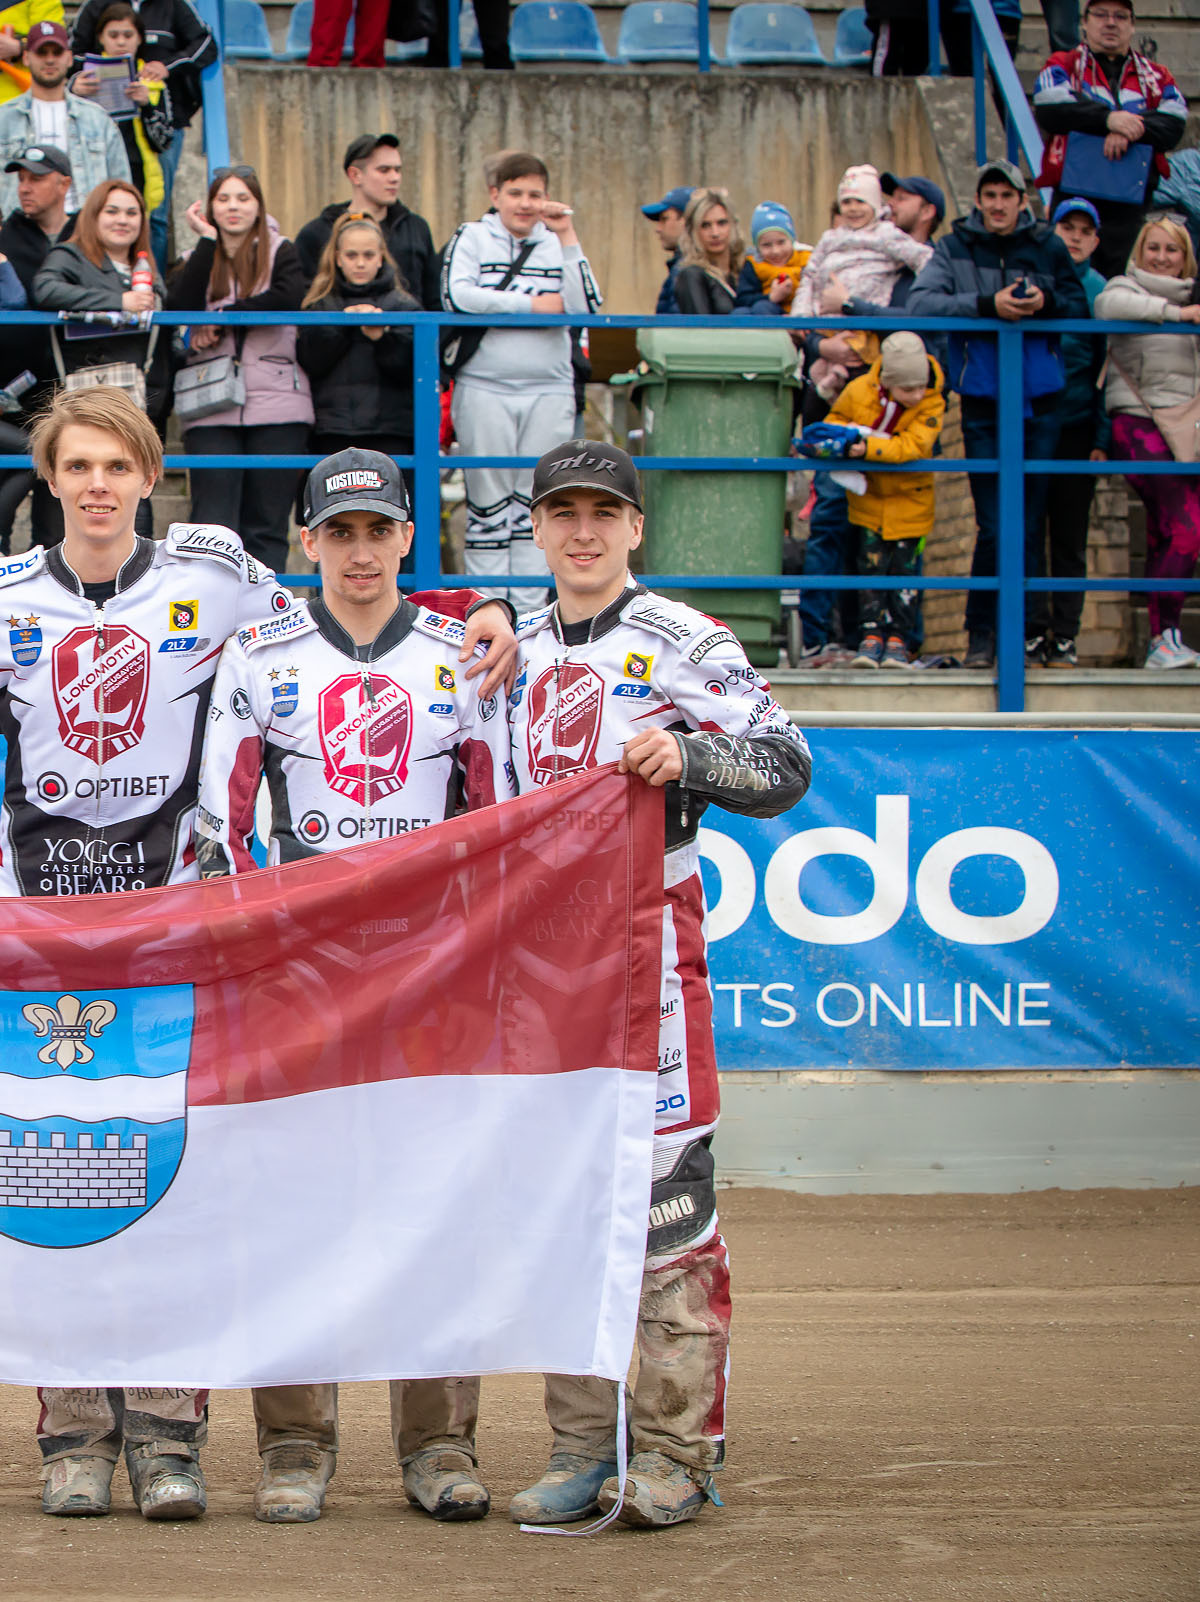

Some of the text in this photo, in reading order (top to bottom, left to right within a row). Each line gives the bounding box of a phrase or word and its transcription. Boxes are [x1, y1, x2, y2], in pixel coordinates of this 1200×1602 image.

[259, 609, 302, 631] PART
[260, 617, 305, 637] SERVICE
[62, 639, 137, 705] LOKOMOTIV
[532, 677, 593, 741] LOKOMOTIV
[75, 775, 170, 800] OPTIBET
[44, 838, 147, 865] YOGGI
[56, 873, 128, 897] BEAR
[816, 982, 1053, 1029] ONLINE
[648, 1195, 696, 1229] OMO
